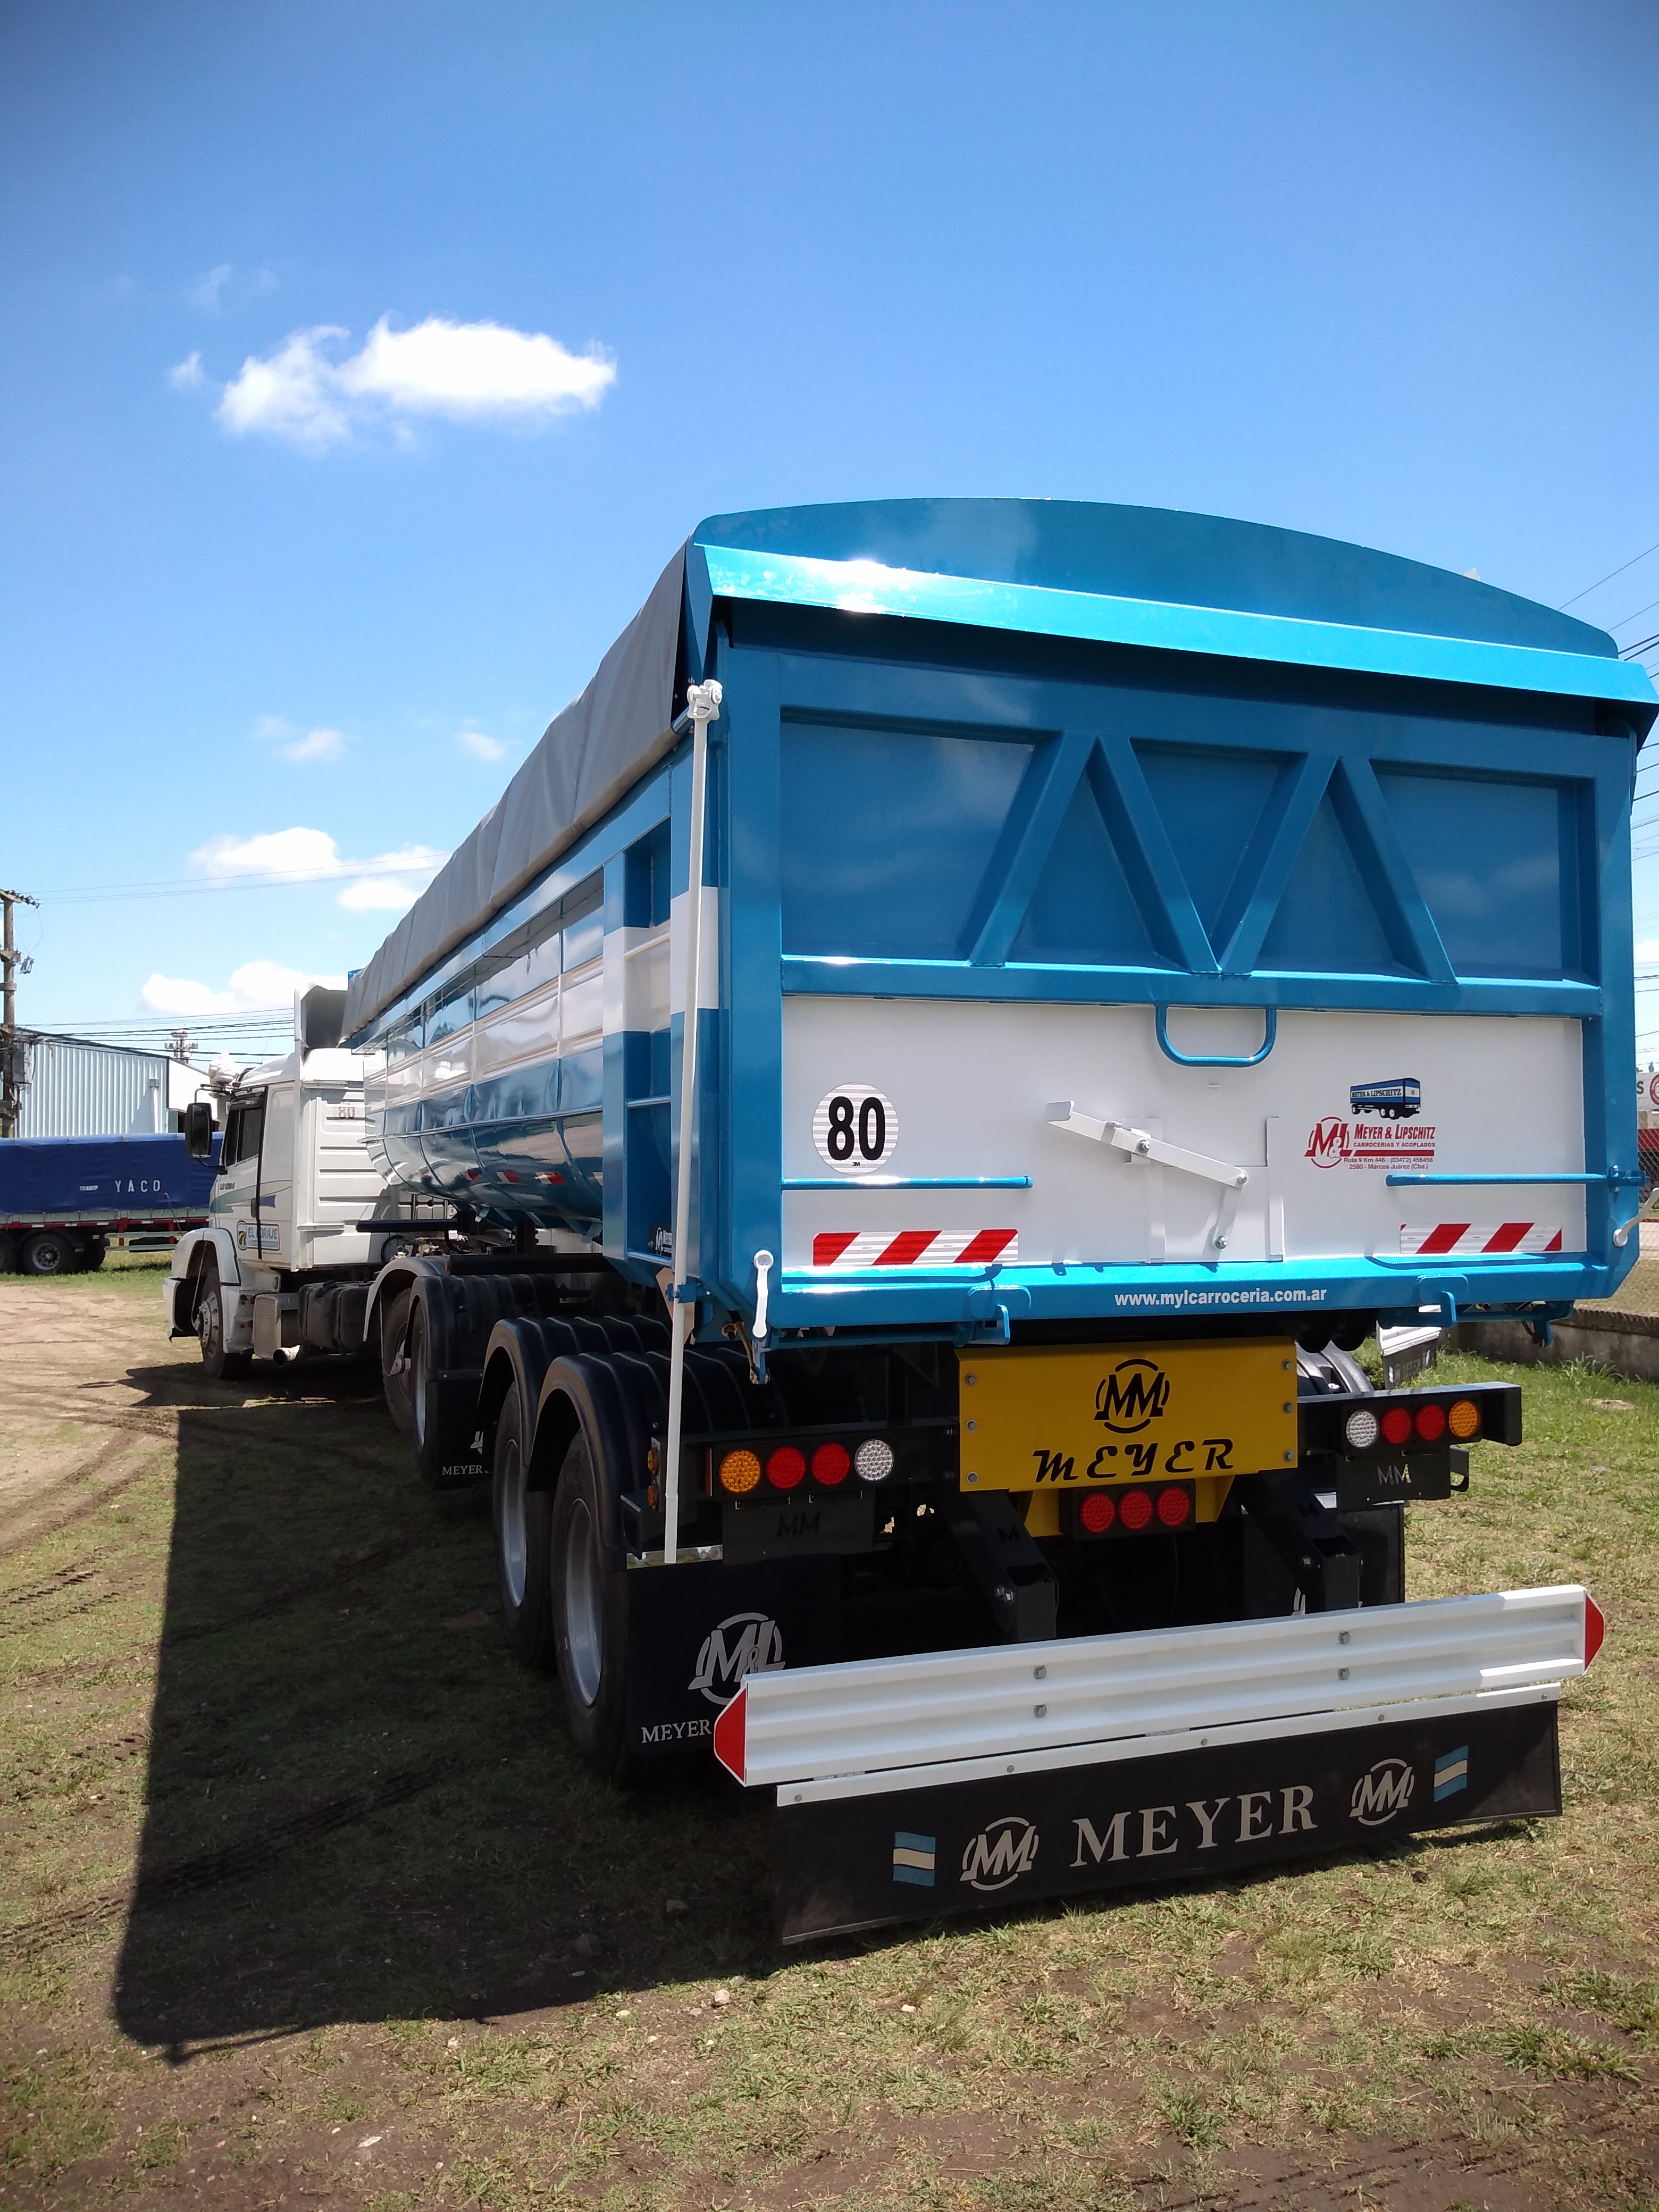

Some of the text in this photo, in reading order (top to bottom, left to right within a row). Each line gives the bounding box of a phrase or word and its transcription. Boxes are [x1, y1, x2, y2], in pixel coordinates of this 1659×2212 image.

[338, 1104, 355, 1119] 80
[827, 1096, 885, 1161] 80
[1354, 1124, 1436, 1139] MEYER & LIPSCHITZ
[115, 1179, 160, 1193] YACO
[248, 1227, 278, 1239] EL ORAJE
[1114, 1287, 1327, 1309] www.mylcarroceria.com.ar
[442, 1464, 483, 1476] MEYER
[1377, 1463, 1412, 1486] MM
[776, 1511, 820, 1537] MM
[641, 1719, 713, 1744] MEYER
[1069, 1784, 1318, 1869] MEYER
